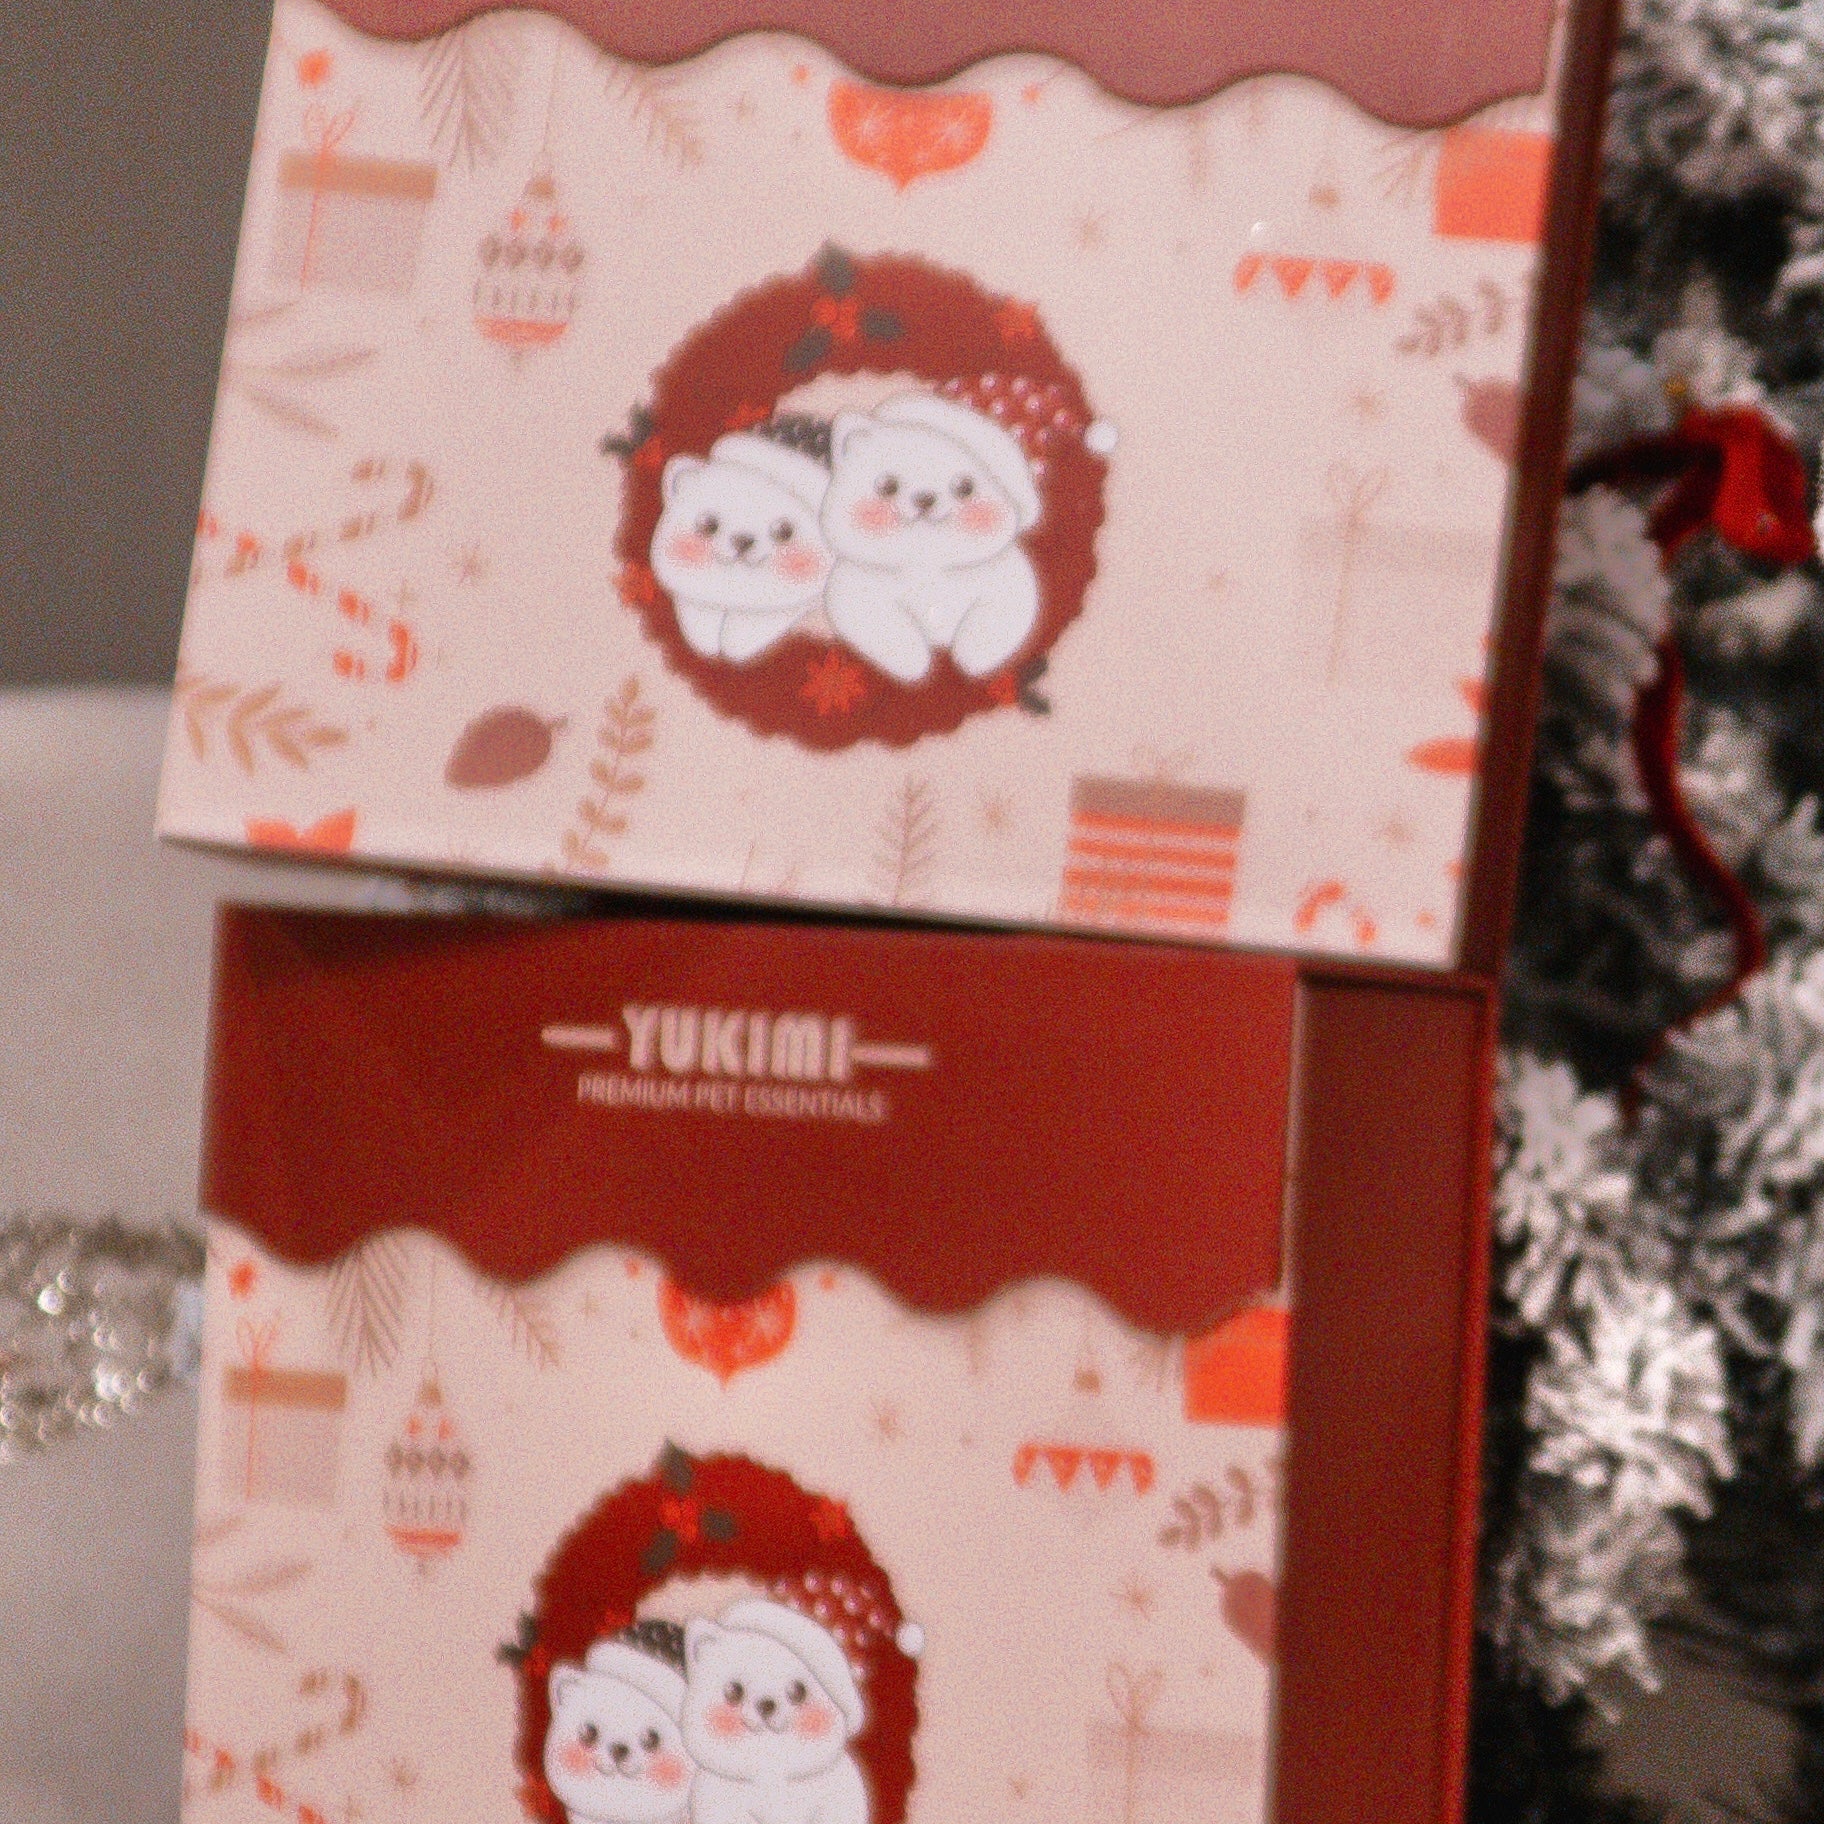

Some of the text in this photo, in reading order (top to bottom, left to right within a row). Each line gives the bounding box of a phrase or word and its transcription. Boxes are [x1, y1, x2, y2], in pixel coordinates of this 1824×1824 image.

[623, 1004, 852, 1082] YUKIMI
[577, 1072, 890, 1124] PREMIUM PET ESSENTIALS
